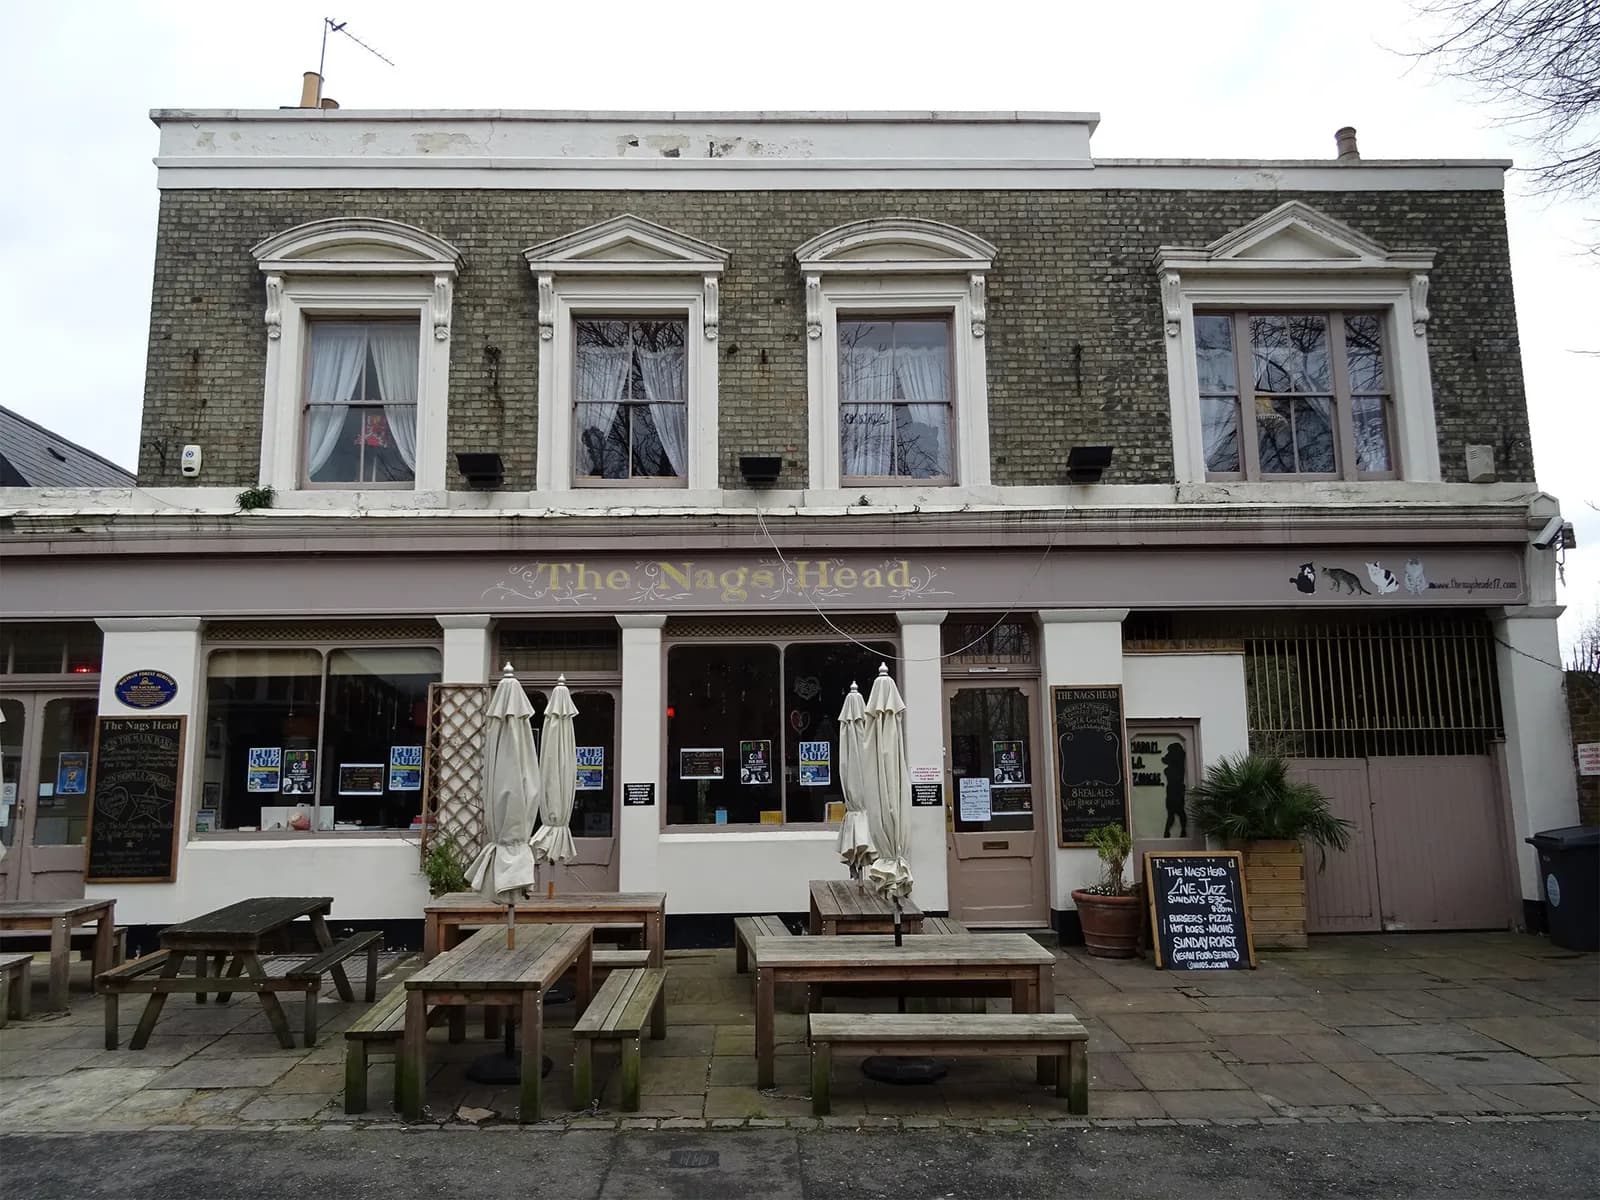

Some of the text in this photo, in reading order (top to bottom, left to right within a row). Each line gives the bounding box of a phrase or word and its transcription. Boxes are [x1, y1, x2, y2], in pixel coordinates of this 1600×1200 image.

[536, 560, 913, 601] The Nags Head
[1057, 690, 1118, 700] THE NAGS HEAD
[103, 720, 179, 732] The Nags Head
[393, 747, 420, 757] PUB
[576, 748, 602, 757] PUB
[802, 743, 828, 752] PUB
[252, 749, 279, 758] PUB
[801, 752, 829, 761] QUIZ
[251, 758, 279, 767] QUIZ
[392, 756, 421, 765] QUIZ
[1071, 787, 1078, 798] 8
[1097, 788, 1114, 798] ALES
[1164, 865, 1227, 877] THE NAGS HEAD
[1167, 877, 1227, 896] LIVE JAZZ
[1167, 895, 1206, 904] SUNDAYS
[1168, 913, 1232, 923] BURGERS PIZZA
[1169, 924, 1183, 933] HOT
[1184, 925, 1205, 934] DOGS
[1173, 935, 1237, 950] SUNDAY ROAST
[1196, 951, 1213, 961] FOOD
